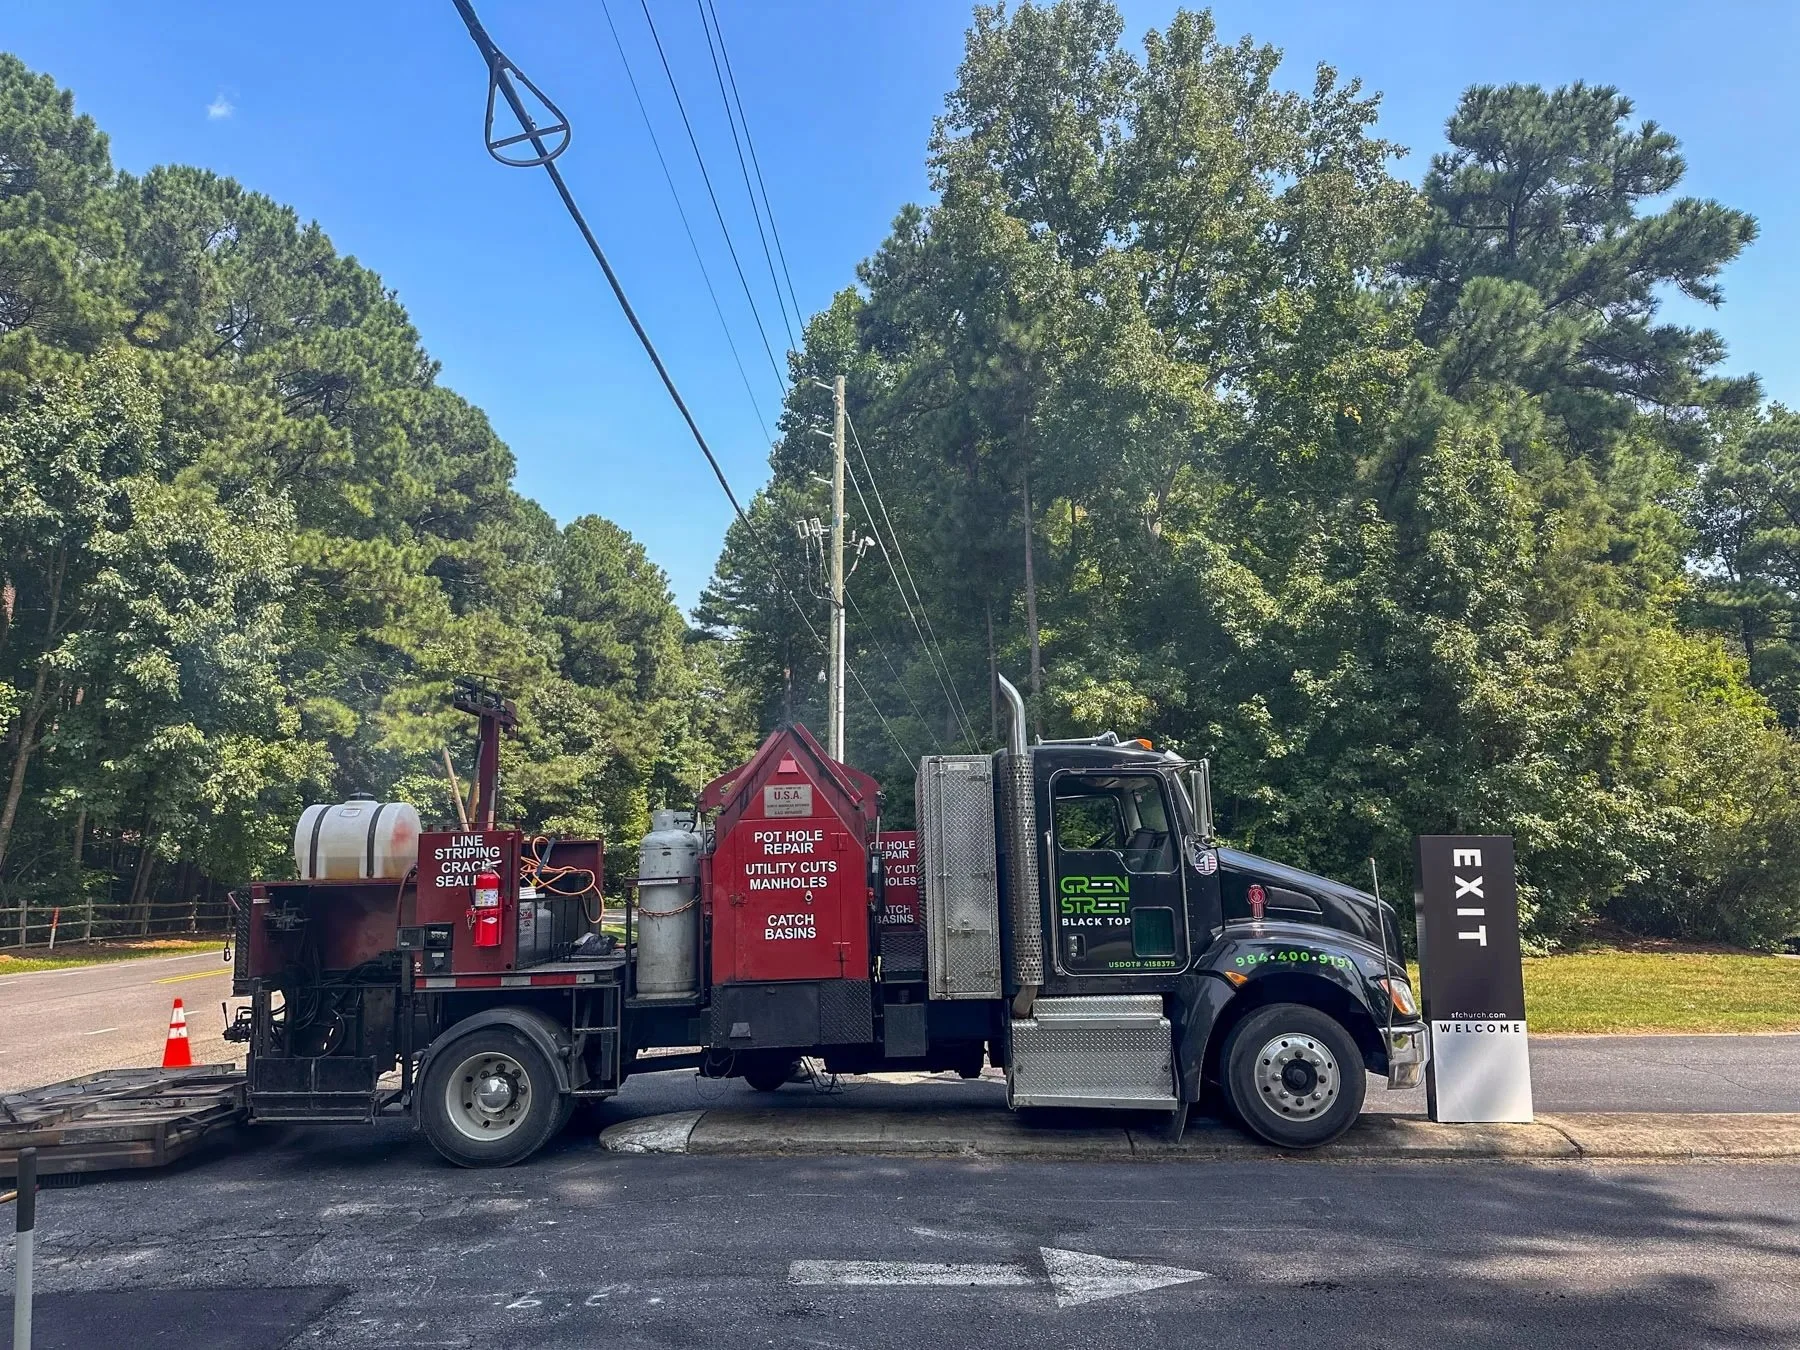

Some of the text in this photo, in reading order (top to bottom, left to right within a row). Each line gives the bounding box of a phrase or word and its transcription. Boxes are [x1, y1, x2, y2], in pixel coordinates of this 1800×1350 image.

[774, 790, 802, 800] U.S.A.
[452, 835, 483, 847] LINE
[754, 830, 823, 842] POT HOLE
[764, 843, 814, 854] REPAIR
[887, 841, 915, 850] HOLE
[434, 847, 500, 859] STRIPING
[745, 861, 837, 875] UTILITY CUTS
[749, 877, 827, 890] MANHOLES
[1061, 876, 1129, 893] GREEN
[1453, 849, 1487, 946] EXIT
[1061, 897, 1129, 914] STREET
[767, 914, 814, 926] CATCH
[1062, 917, 1131, 926] BLACK TOP
[765, 926, 816, 940] BASINS
[1439, 1023, 1520, 1033] WELCOME
